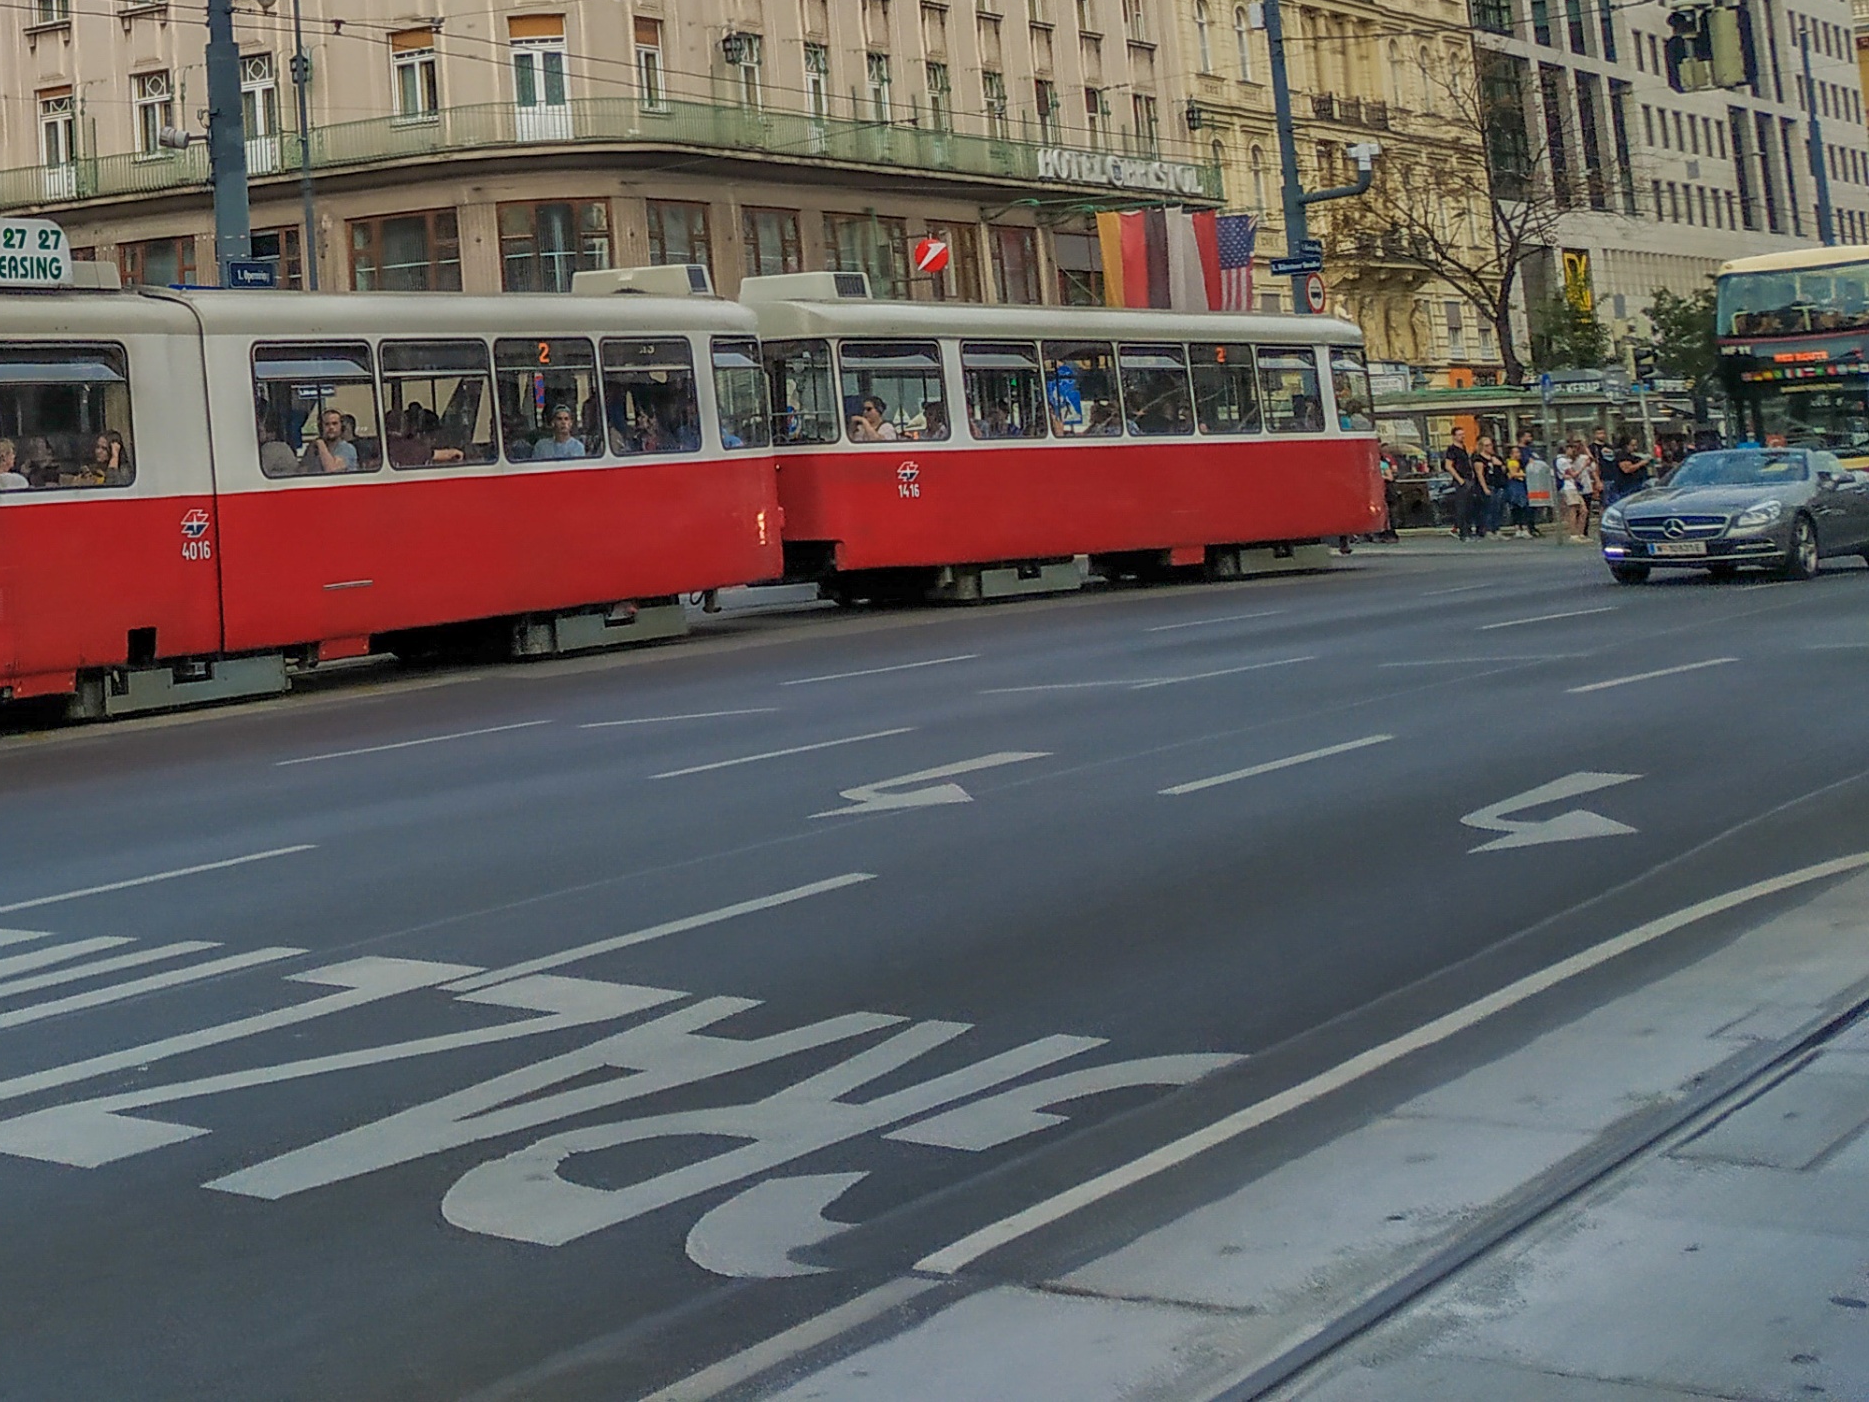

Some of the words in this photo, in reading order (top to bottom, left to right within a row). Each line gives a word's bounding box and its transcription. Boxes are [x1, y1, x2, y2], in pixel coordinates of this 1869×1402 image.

[1037, 148, 1109, 184] HOTEL
[2, 227, 28, 249] 27
[38, 229, 62, 250] 27
[538, 341, 550, 364] 2
[1215, 346, 1226, 364] 2
[898, 483, 920, 498] 1416
[181, 540, 212, 561] 4016
